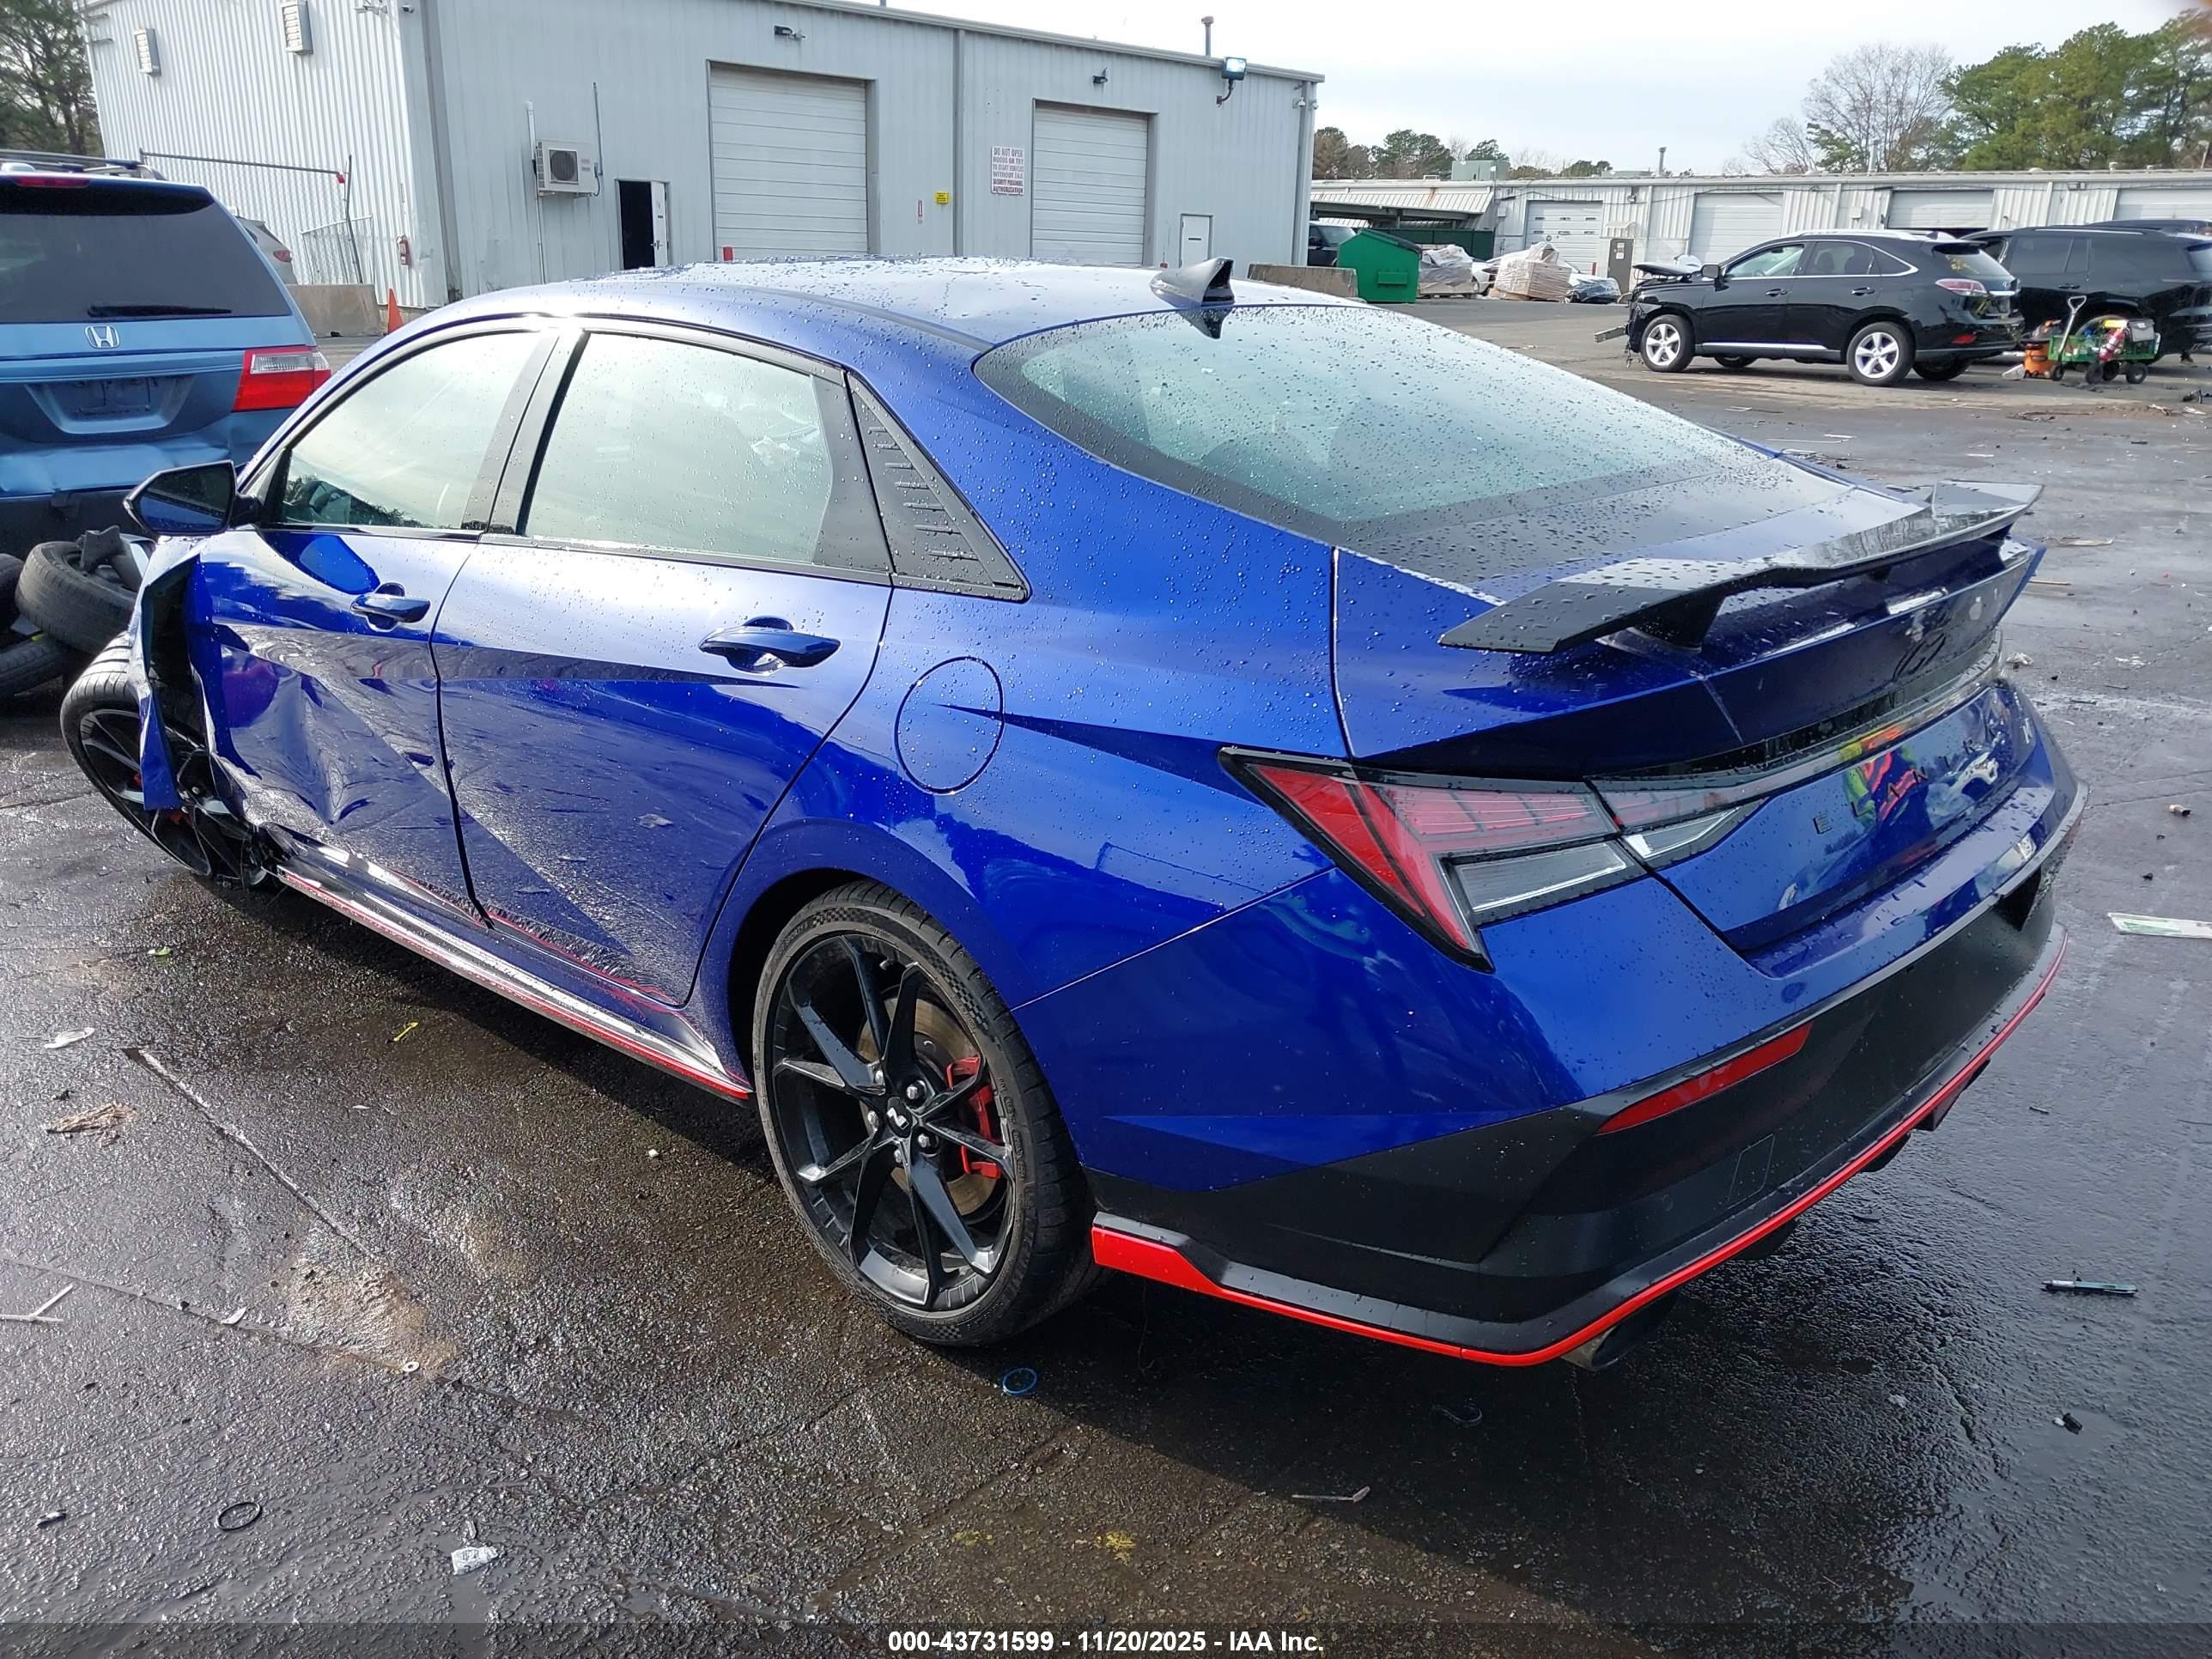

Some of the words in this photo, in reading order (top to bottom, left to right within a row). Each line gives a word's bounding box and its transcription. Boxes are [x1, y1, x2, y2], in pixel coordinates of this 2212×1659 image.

[994, 147, 1000, 155] DO
[1002, 148, 1011, 156] NOT
[1012, 149, 1024, 158] OPEN
